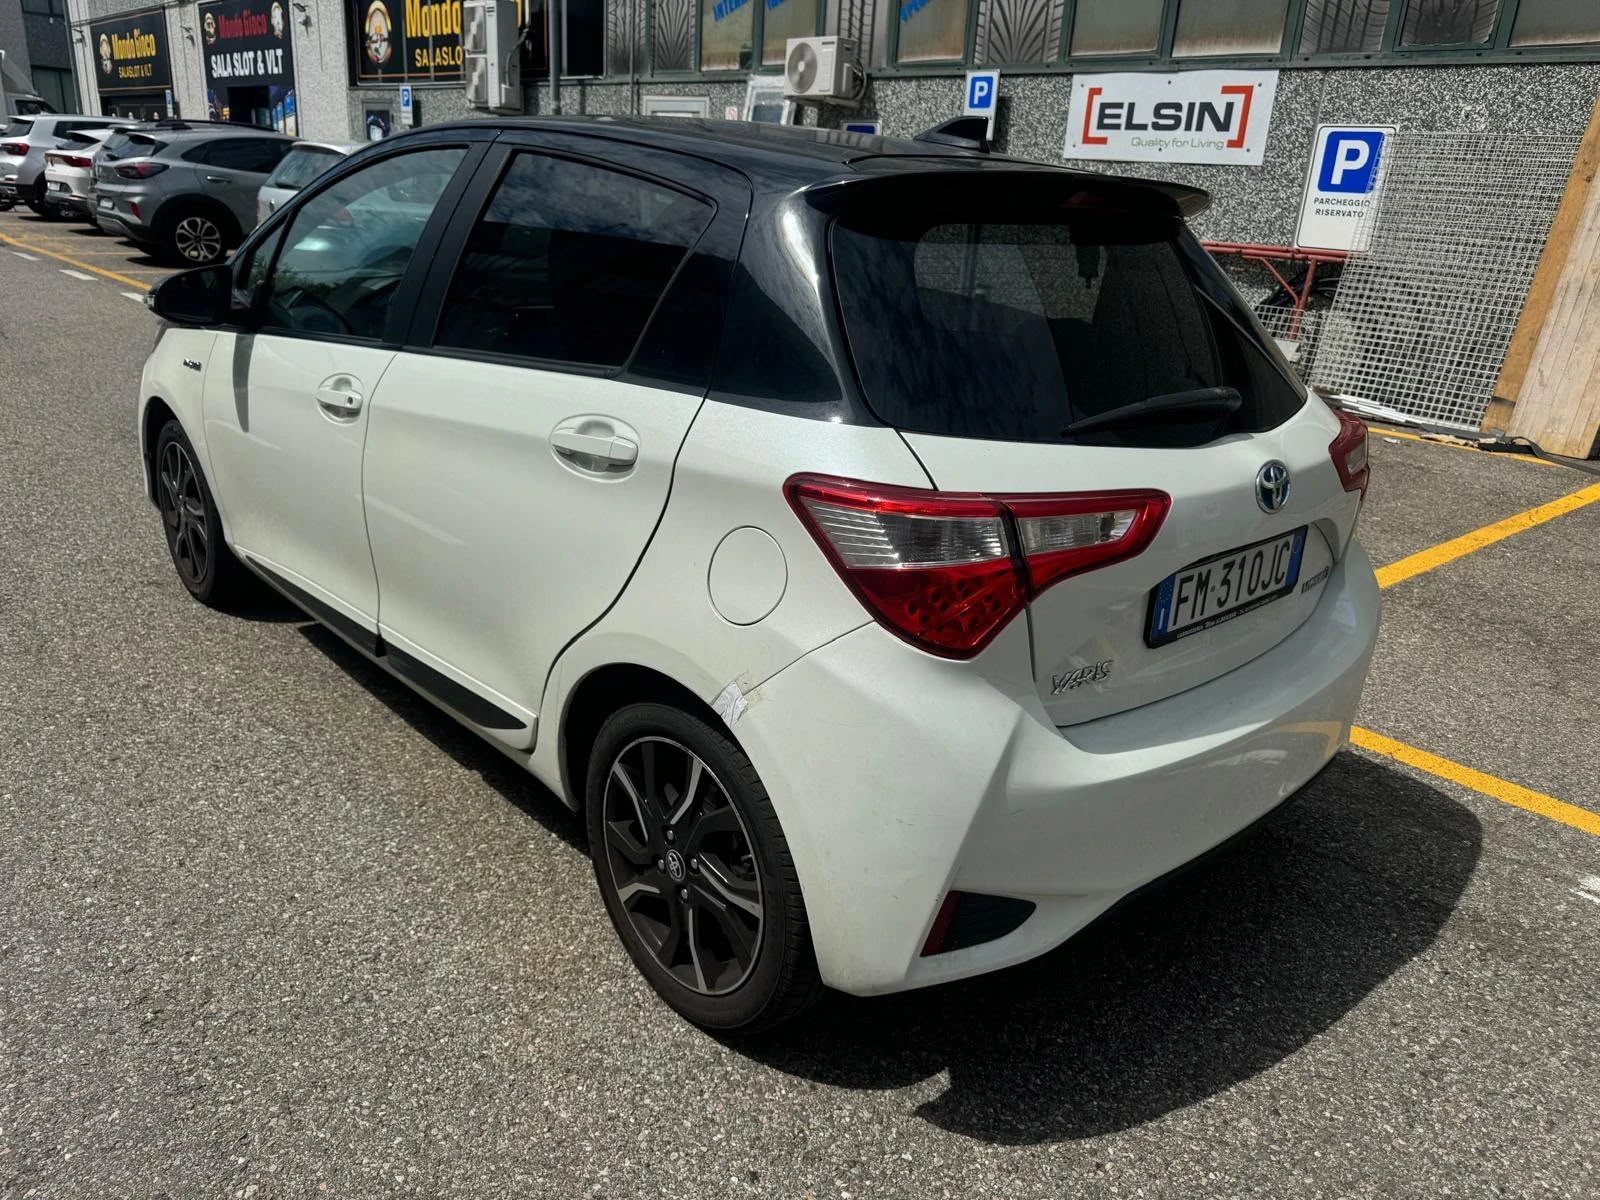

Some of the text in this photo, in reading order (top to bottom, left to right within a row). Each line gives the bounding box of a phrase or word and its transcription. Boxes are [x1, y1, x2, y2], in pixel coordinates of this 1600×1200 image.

[218, 11, 267, 38] Mondo Gioco
[405, 0, 462, 38] Mondo
[111, 28, 156, 60] Mondo Gioco
[415, 46, 464, 67] SALASLO
[211, 49, 284, 78] SALA SLOT & VLT
[974, 81, 988, 104] P
[1097, 101, 1235, 132] ELSIN
[1131, 137, 1224, 150] Quality for Living
[1331, 140, 1370, 185] P
[1313, 197, 1371, 207] PARCHEGGIO
[1315, 208, 1364, 218] RISERVATO
[1050, 659, 1114, 695] YARIS
